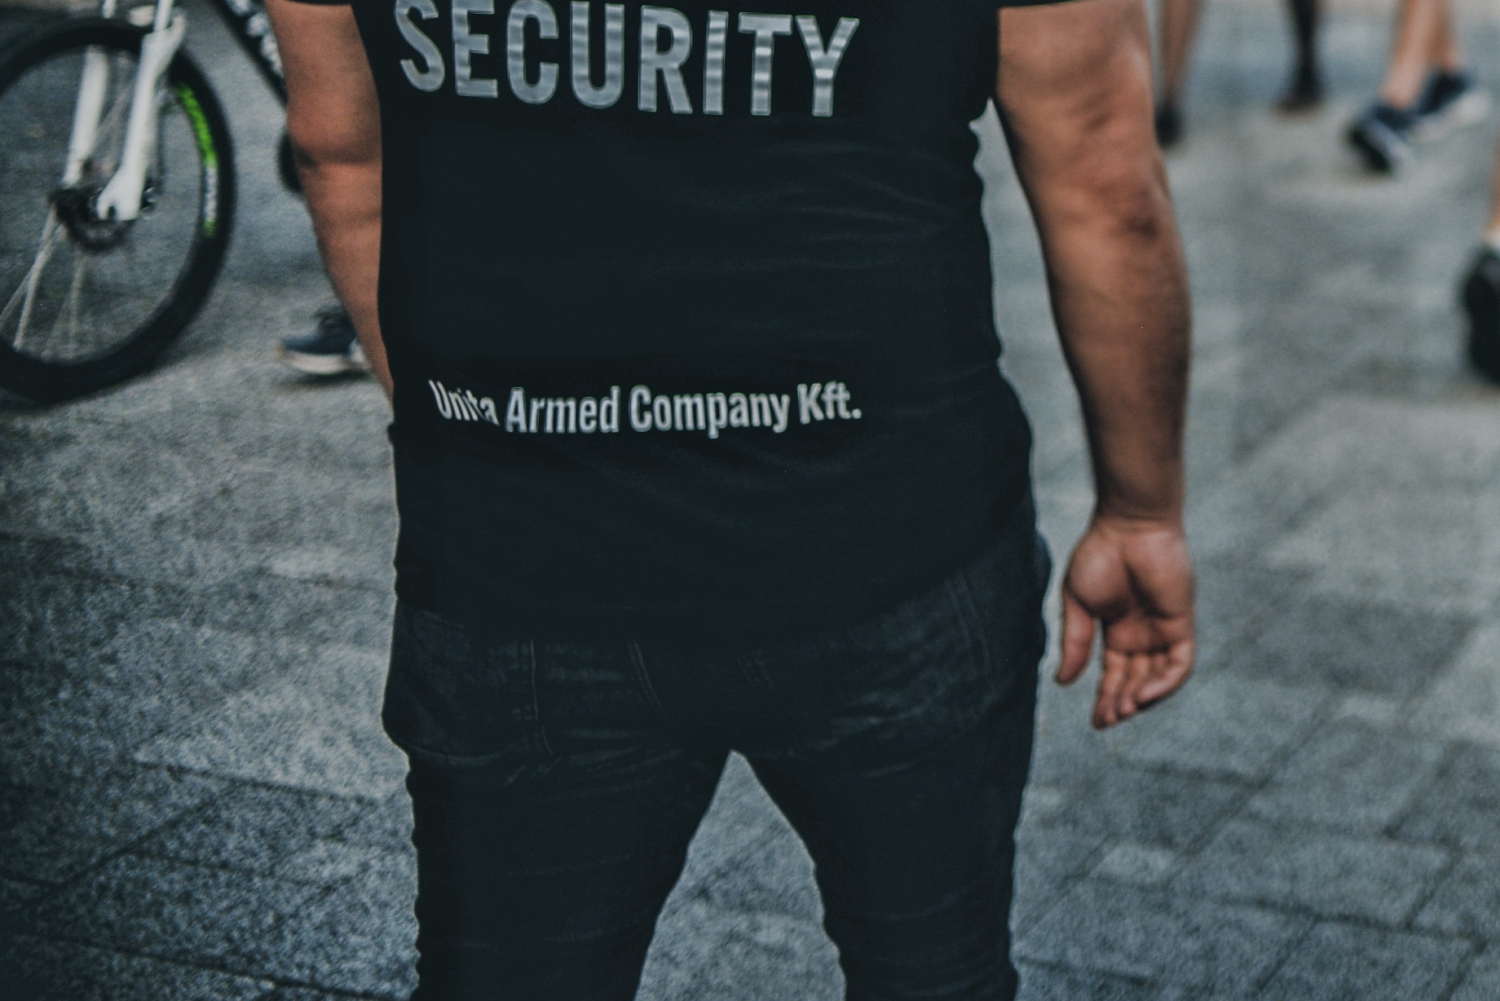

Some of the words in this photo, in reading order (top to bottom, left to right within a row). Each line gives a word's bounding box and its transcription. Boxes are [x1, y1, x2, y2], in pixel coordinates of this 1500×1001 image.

[428, 379, 500, 426] Unita
[505, 386, 620, 433] Armed
[629, 385, 791, 439] Company
[797, 381, 862, 425] Kft.
